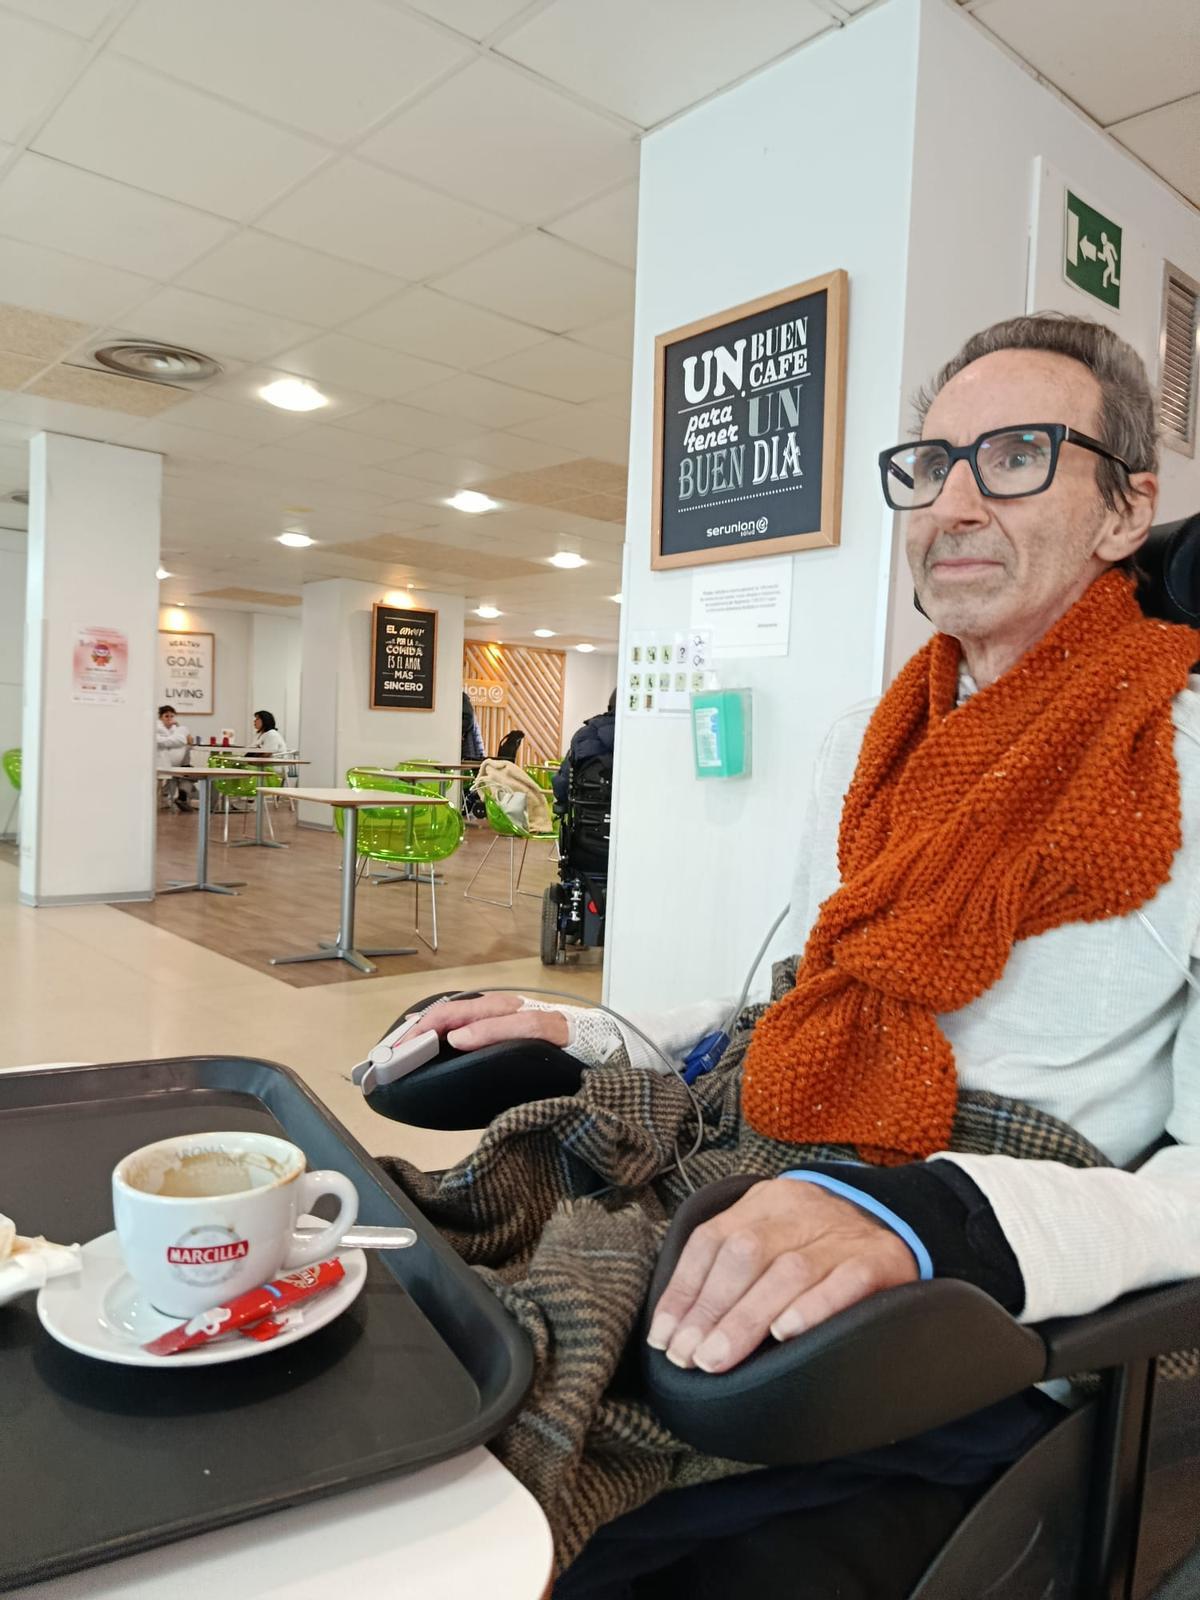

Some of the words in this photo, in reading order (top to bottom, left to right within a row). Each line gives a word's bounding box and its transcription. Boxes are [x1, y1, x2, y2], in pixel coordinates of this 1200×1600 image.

[682, 339, 747, 403] UN
[751, 316, 808, 360] BUEN
[749, 349, 807, 387] CAFE
[684, 404, 733, 440] para
[747, 384, 803, 437] UN
[687, 423, 739, 454] tener
[679, 444, 746, 500] BUEN
[752, 431, 803, 485] DIA
[706, 520, 755, 538] serunion
[386, 625, 397, 634] EL
[396, 637, 406, 645] POR
[407, 638, 414, 646] LA
[385, 646, 423, 656] COMIDA
[166, 656, 204, 669] GOAL
[387, 656, 396, 669] ES
[396, 656, 403, 669] EL
[404, 656, 421, 670] AMOR
[165, 688, 204, 699] LIVING
[383, 681, 423, 691] SINCERO
[169, 1243, 246, 1263] MARCILLA
